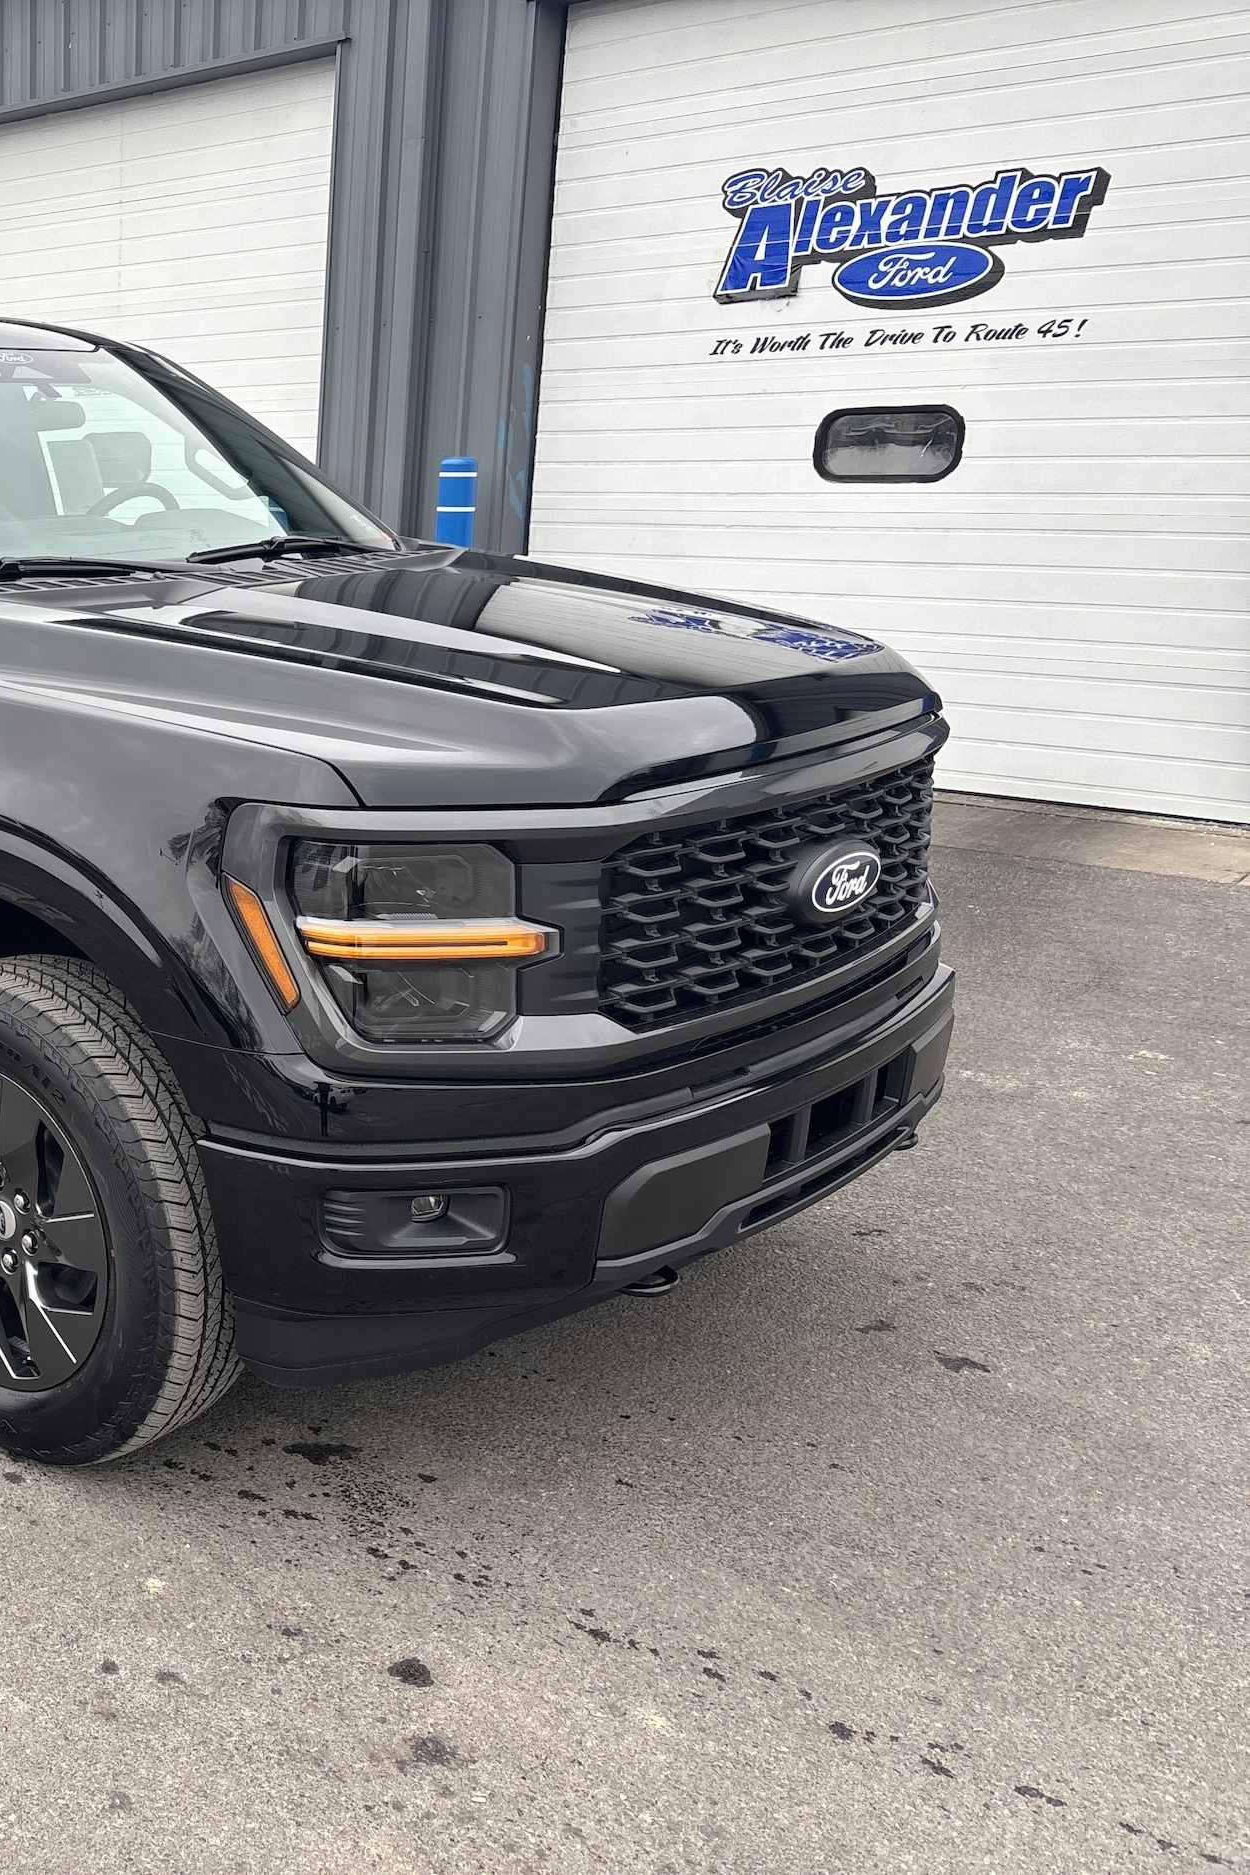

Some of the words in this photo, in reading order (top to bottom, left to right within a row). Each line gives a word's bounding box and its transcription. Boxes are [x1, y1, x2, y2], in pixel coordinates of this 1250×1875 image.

[722, 169, 867, 210] Blaise
[715, 170, 1098, 297] Alexander
[867, 251, 957, 290] Ford
[708, 338, 744, 356] It's
[749, 332, 812, 354] Worth
[818, 330, 854, 350] The
[863, 328, 925, 347] Drive
[931, 324, 957, 344] To
[963, 322, 1029, 342] Route
[825, 860, 871, 906] Ford
